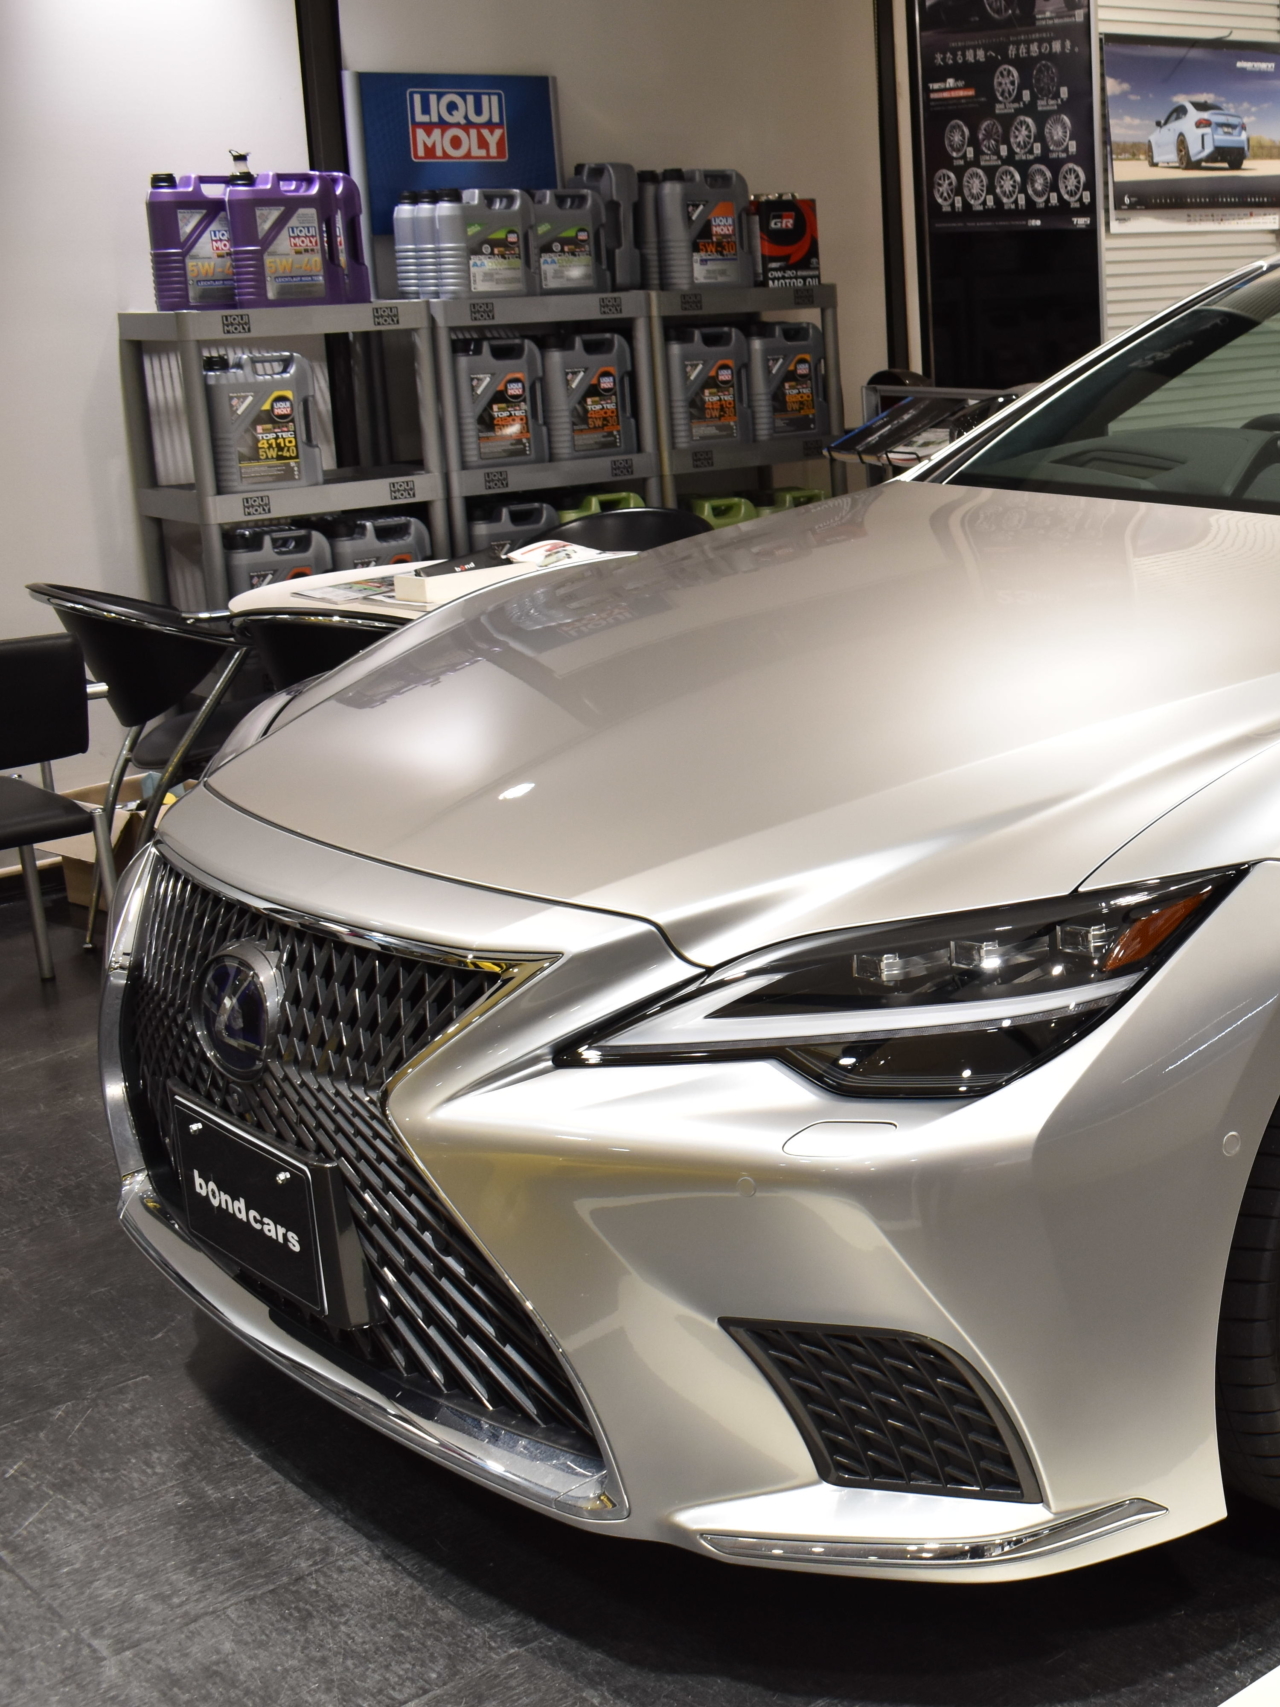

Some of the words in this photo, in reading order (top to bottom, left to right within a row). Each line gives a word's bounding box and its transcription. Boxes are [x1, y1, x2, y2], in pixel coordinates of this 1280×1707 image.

[413, 93, 500, 125] LIQUI
[416, 127, 503, 158] MOLY
[712, 217, 733, 225] LIQUI
[770, 218, 794, 229] GR
[289, 227, 316, 237] LIQUI
[712, 225, 734, 235] MOLY
[211, 231, 229, 240] LIQ
[213, 240, 230, 250] MO
[291, 237, 318, 247] MOLY
[699, 242, 736, 254] 5W-30
[188, 261, 234, 277] 5W-4
[266, 257, 322, 274] 5W-40
[768, 270, 796, 278] 0W-20
[600, 297, 621, 306] LIQUI
[373, 307, 398, 316] LIQUI
[471, 303, 493, 312] LIQUI
[601, 306, 622, 314] MOLY
[223, 315, 249, 324] LIQUI
[374, 316, 399, 325] MOLY
[472, 312, 494, 320] MOLY
[224, 324, 250, 333] MOLY
[705, 400, 734, 409] 4210
[587, 409, 617, 418] 4200
[705, 407, 735, 418] 0W-30
[494, 416, 526, 425] 4200
[588, 416, 617, 428] 5W-30
[257, 437, 296, 449] 4110
[259, 447, 297, 460] 5W-40
[611, 460, 632, 468] LIQUI
[485, 472, 507, 481] LIQUI
[612, 468, 633, 476] MOLY
[390, 482, 414, 490] LIQUI
[486, 480, 508, 489] MOLY
[391, 490, 415, 500] MOLY
[244, 496, 269, 506] LIQUI
[244, 506, 270, 516] MOLY
[454, 561, 476, 572] bond
